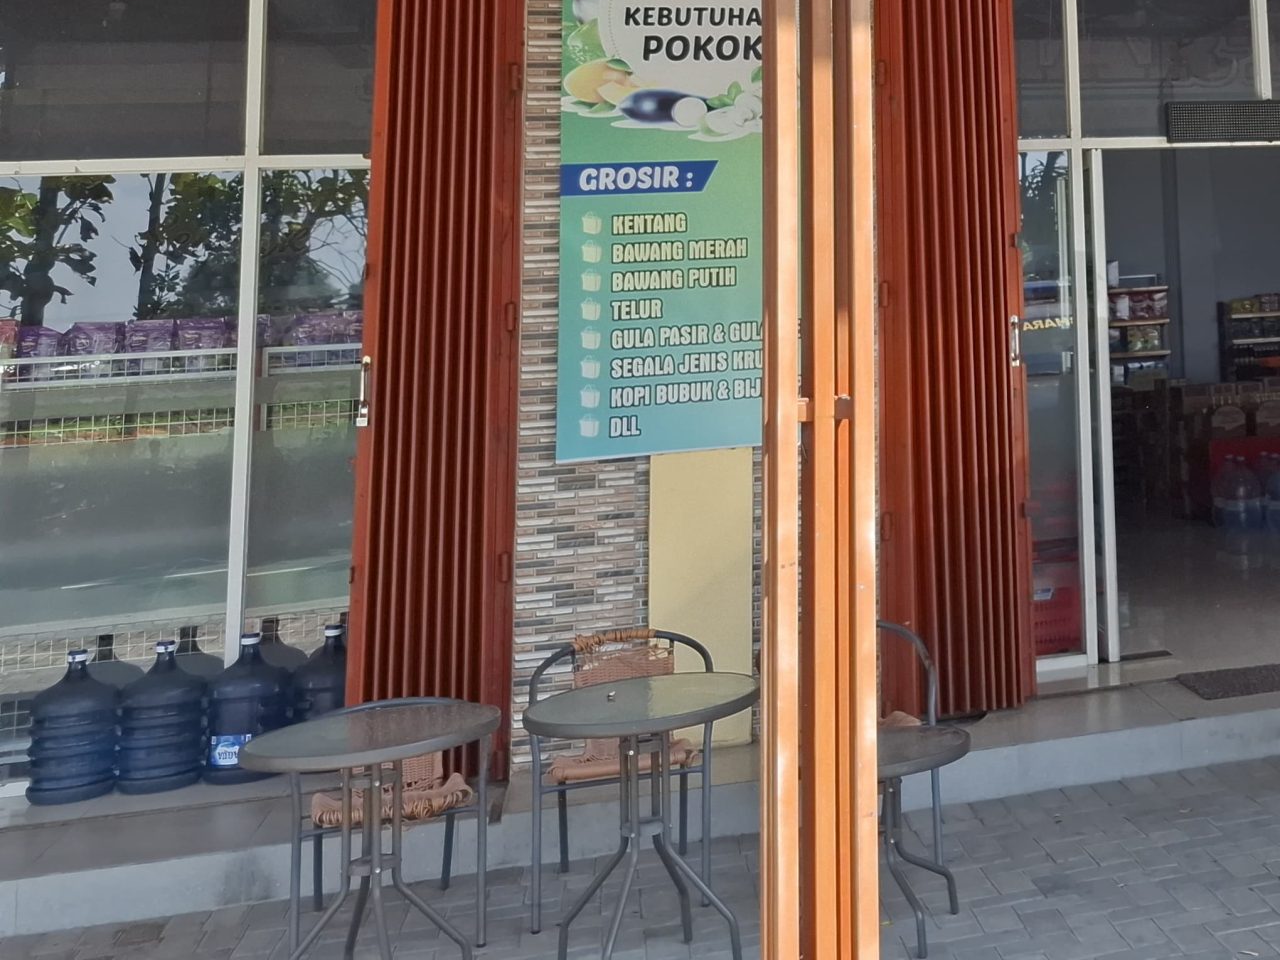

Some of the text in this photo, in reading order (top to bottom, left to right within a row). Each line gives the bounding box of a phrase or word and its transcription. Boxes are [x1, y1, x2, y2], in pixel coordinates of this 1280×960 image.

[624, 7, 762, 27] KEBUTUHA
[642, 35, 762, 62] POKOK
[579, 166, 679, 190] GROSIR
[612, 213, 687, 235] KENTANG
[612, 238, 748, 264] BAWANG MERAH
[612, 266, 737, 292] BAWANG PUTIH
[611, 298, 663, 321] TELUR
[611, 328, 655, 349] GULA
[659, 324, 709, 346] PASIR
[713, 323, 726, 342] &
[610, 350, 762, 378] SEGALA JENIS KRU
[610, 378, 762, 408] KOPI BUBUK & BIJ
[609, 416, 641, 438] DLL
